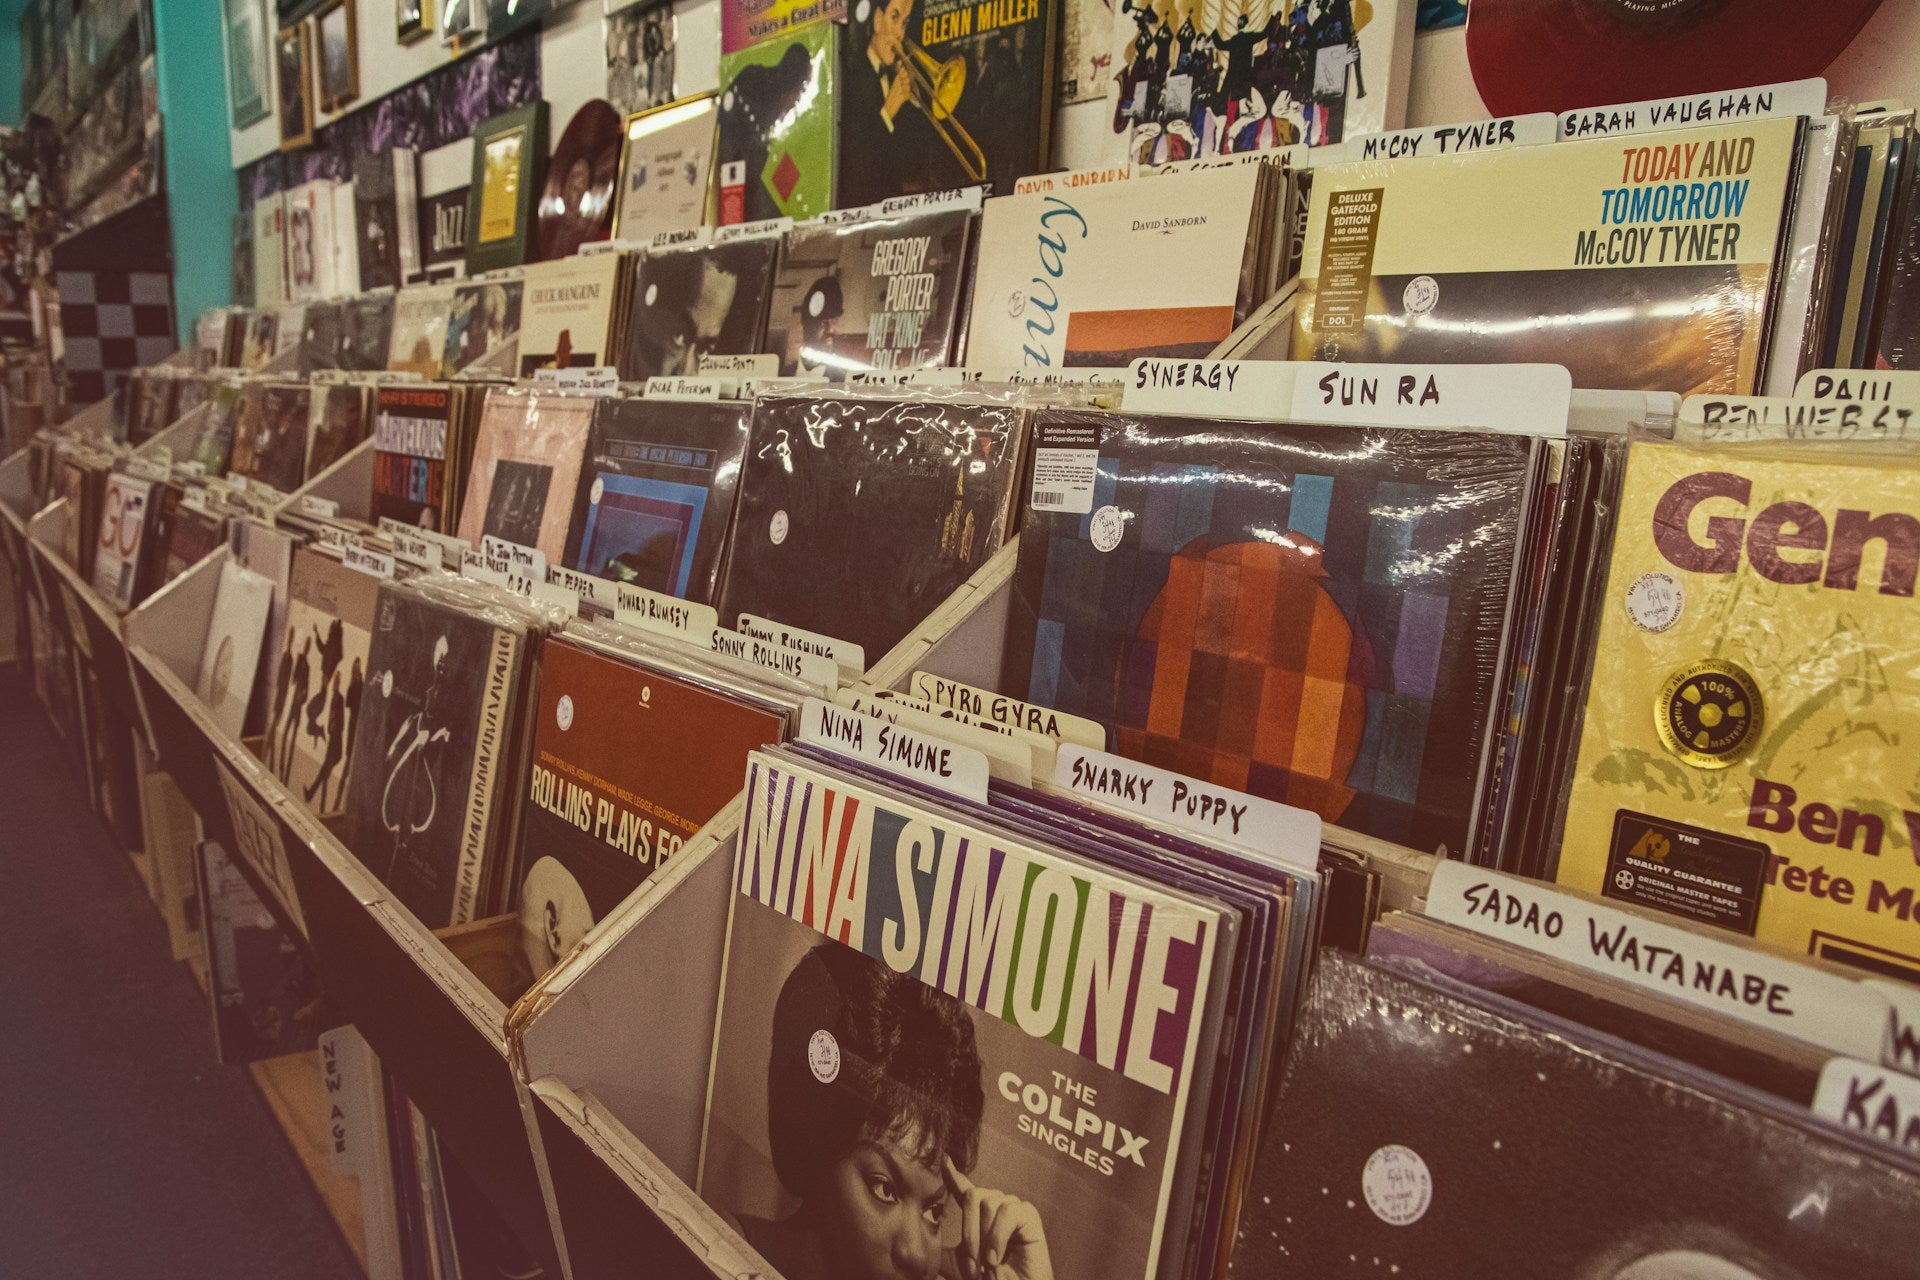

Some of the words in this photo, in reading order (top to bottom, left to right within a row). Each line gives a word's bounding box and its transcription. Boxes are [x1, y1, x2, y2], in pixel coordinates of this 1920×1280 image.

[922, 7, 972, 46] GLENN
[977, 0, 1039, 32] MILLER
[1624, 1, 1656, 12] PLAYING
[1564, 110, 1636, 137] SARAH
[1650, 92, 1773, 123] VAUGHAN
[1434, 120, 1515, 152] TYNER
[1622, 146, 1697, 184] TODAY
[1699, 136, 1754, 176] AND
[1331, 203, 1378, 216] GATEFOLD
[1338, 192, 1374, 204] DELUXE
[1601, 179, 1750, 224] TOMORROW
[1132, 218, 1162, 232] DAVID
[1163, 215, 1207, 230] SANBORN
[1334, 215, 1371, 227] EDITION
[1347, 226, 1368, 235] GRAM
[870, 236, 931, 277] GREGORY
[1574, 227, 1653, 266] McCOY
[1659, 222, 1740, 262] TYNER
[884, 272, 935, 312] PORTER
[866, 313, 892, 348] NAT
[1329, 317, 1346, 325] DOL
[676, 380, 713, 396] PETERSON
[1136, 362, 1240, 393] SYNERGY
[1319, 371, 1378, 406] SUN
[1398, 373, 1441, 406] RA
[1703, 402, 1769, 438] BEN
[1785, 405, 1920, 440] WEBST
[1652, 471, 1920, 598] Gen
[564, 572, 595, 599] PEPPER
[1627, 580, 1641, 596] VINYL
[1640, 573, 1673, 584] SOLUTION
[617, 587, 646, 617] HOWARD
[649, 598, 690, 631] RUMSEY
[712, 630, 746, 659] SONNY
[753, 642, 802, 677] ROLLINS
[781, 632, 834, 661] RUSHING
[1688, 664, 1732, 675] AUTHORIZED
[919, 674, 982, 716] SPYRO
[991, 698, 1061, 739] GYRA
[1701, 681, 1734, 700] 100%
[820, 706, 863, 752] NINA
[878, 725, 952, 777] SIMONE
[1674, 701, 1692, 739] ANALOG
[1710, 720, 1746, 748] MASTERS
[618, 788, 634, 805] WADE
[654, 804, 680, 826] GEORGE
[1072, 756, 1155, 806] SNARKY
[1172, 780, 1248, 835] PUPPY
[530, 764, 592, 832] ROLLINS
[594, 797, 652, 865] PLAYS
[654, 827, 689, 870] FO
[1747, 778, 1885, 857] Ben
[1678, 834, 1700, 846] THE
[1626, 856, 1671, 875] QUALITY
[1674, 869, 1743, 895] GUARANTEE
[1638, 875, 1675, 892] ORIGINAL
[1676, 885, 1710, 901] MASTER
[1712, 895, 1738, 909] TAPES
[1764, 853, 1855, 905] Tete
[1666, 891, 1685, 902] original
[1728, 909, 1742, 918] with
[740, 761, 872, 953] NINA
[881, 819, 1201, 1095] SIMONE
[1463, 883, 1565, 940] SADAO
[1588, 916, 1794, 1017] WATANABE
[322, 1040, 342, 1094] NEW
[1052, 1070, 1098, 1107] THE
[330, 1104, 346, 1154] AGE
[998, 1071, 1150, 1168] COLPIX
[1017, 1114, 1115, 1176] SINGLES
